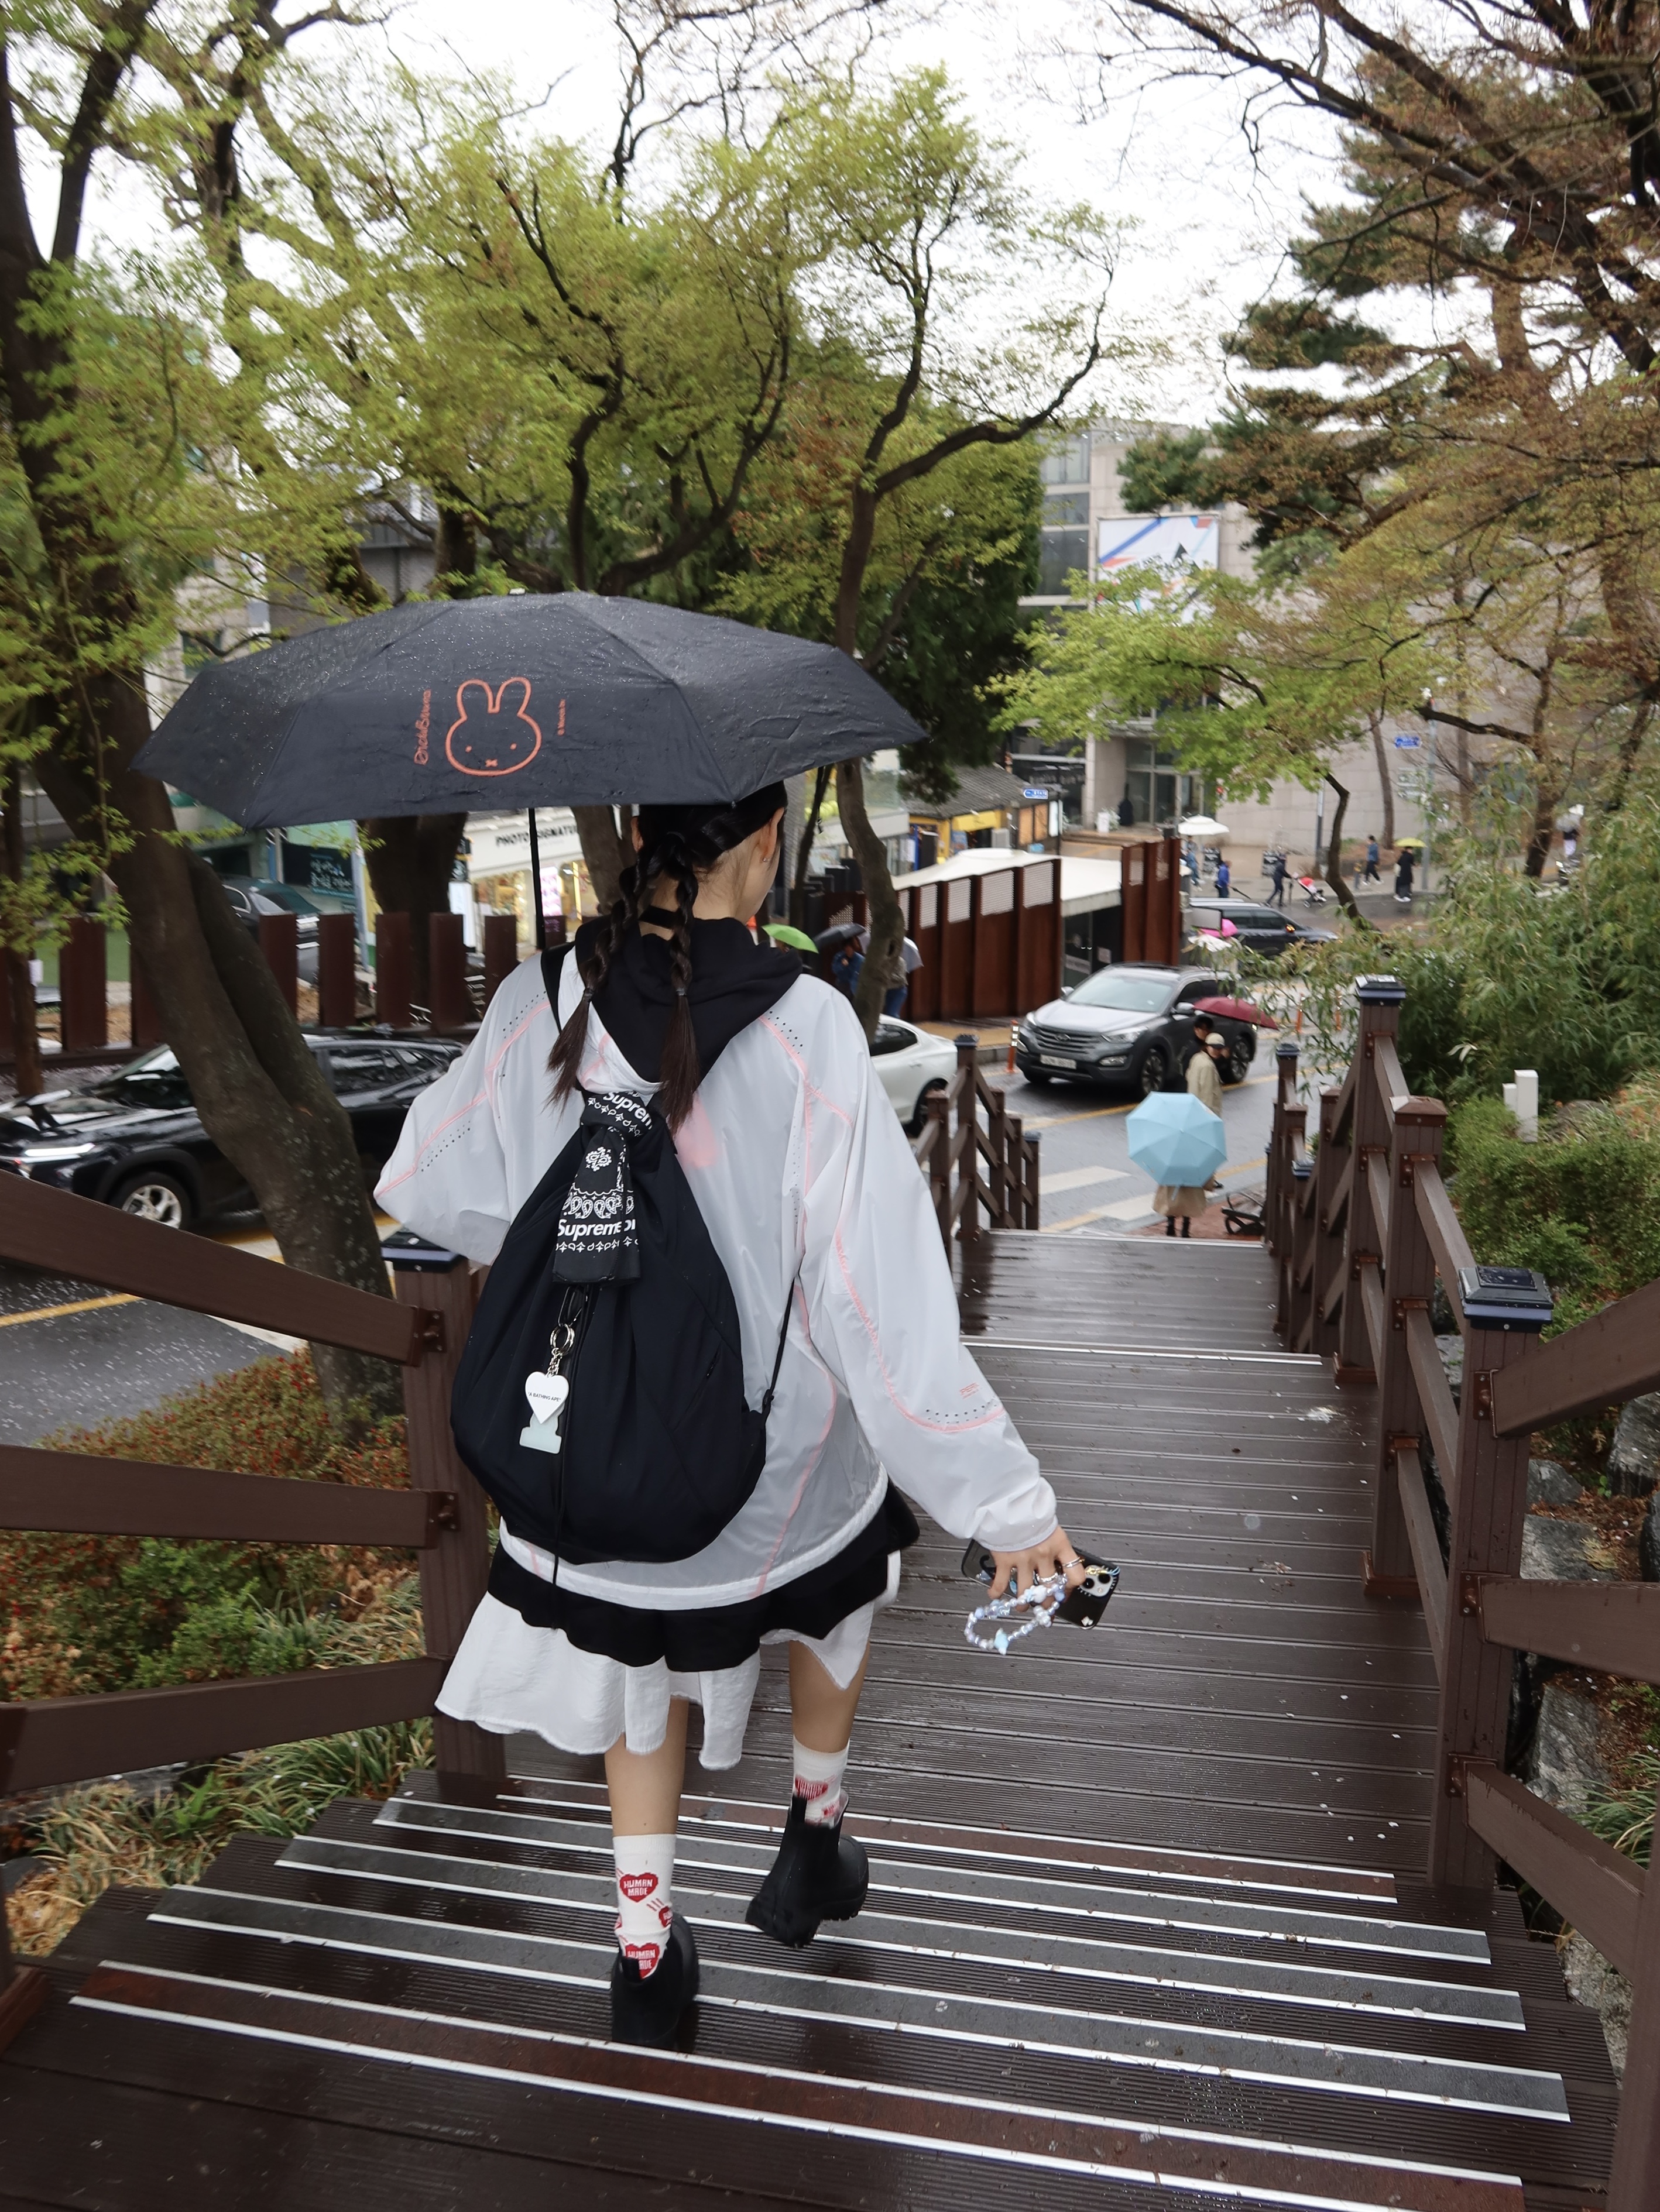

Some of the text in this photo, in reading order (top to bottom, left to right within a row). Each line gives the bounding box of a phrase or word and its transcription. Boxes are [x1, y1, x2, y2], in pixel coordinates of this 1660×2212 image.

[603, 1092, 653, 1130] Suprem
[623, 1878, 653, 1889] HUMAN
[627, 1887, 648, 1896] MADE
[639, 1959, 653, 1970] ADE
